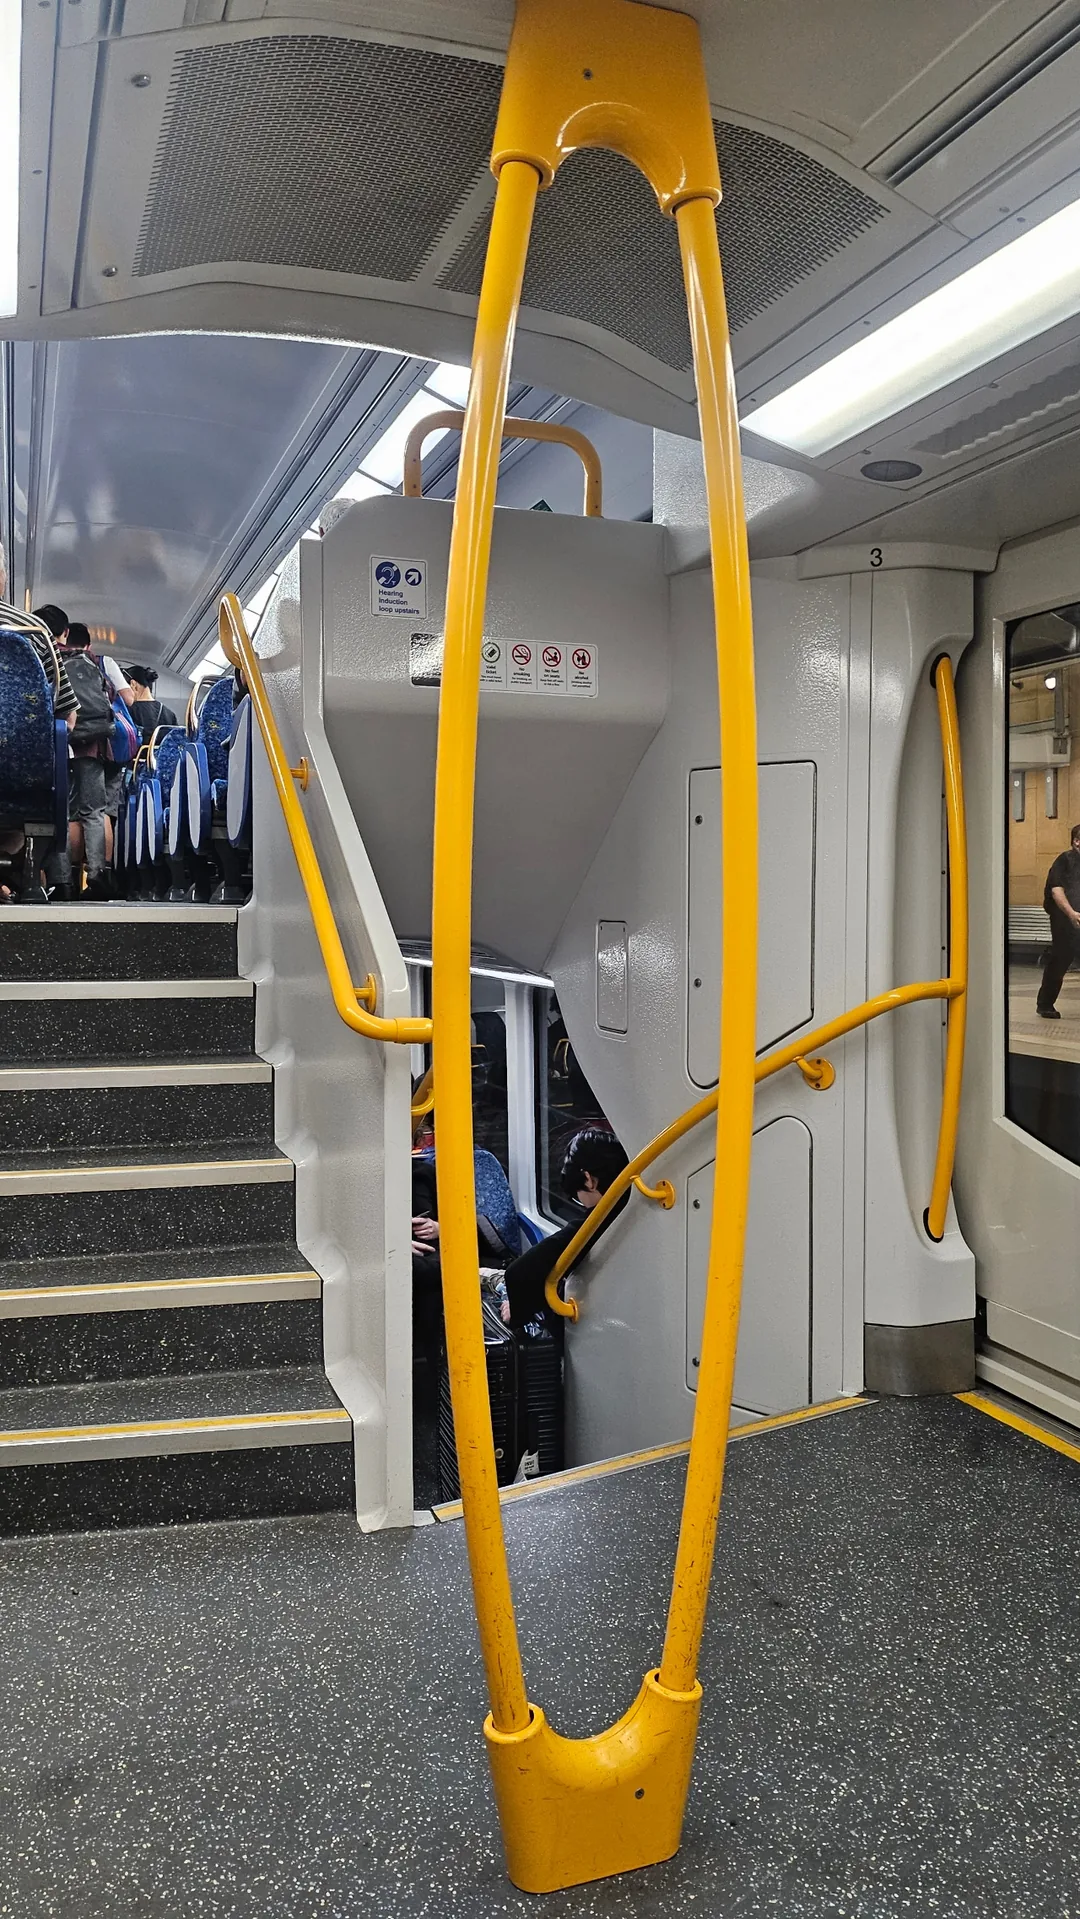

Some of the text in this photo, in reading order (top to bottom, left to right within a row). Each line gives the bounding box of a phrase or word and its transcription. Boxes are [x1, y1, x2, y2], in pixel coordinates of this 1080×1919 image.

[870, 548, 883, 567] 3
[378, 589, 404, 598] Hearing
[378, 605, 393, 613] loop
